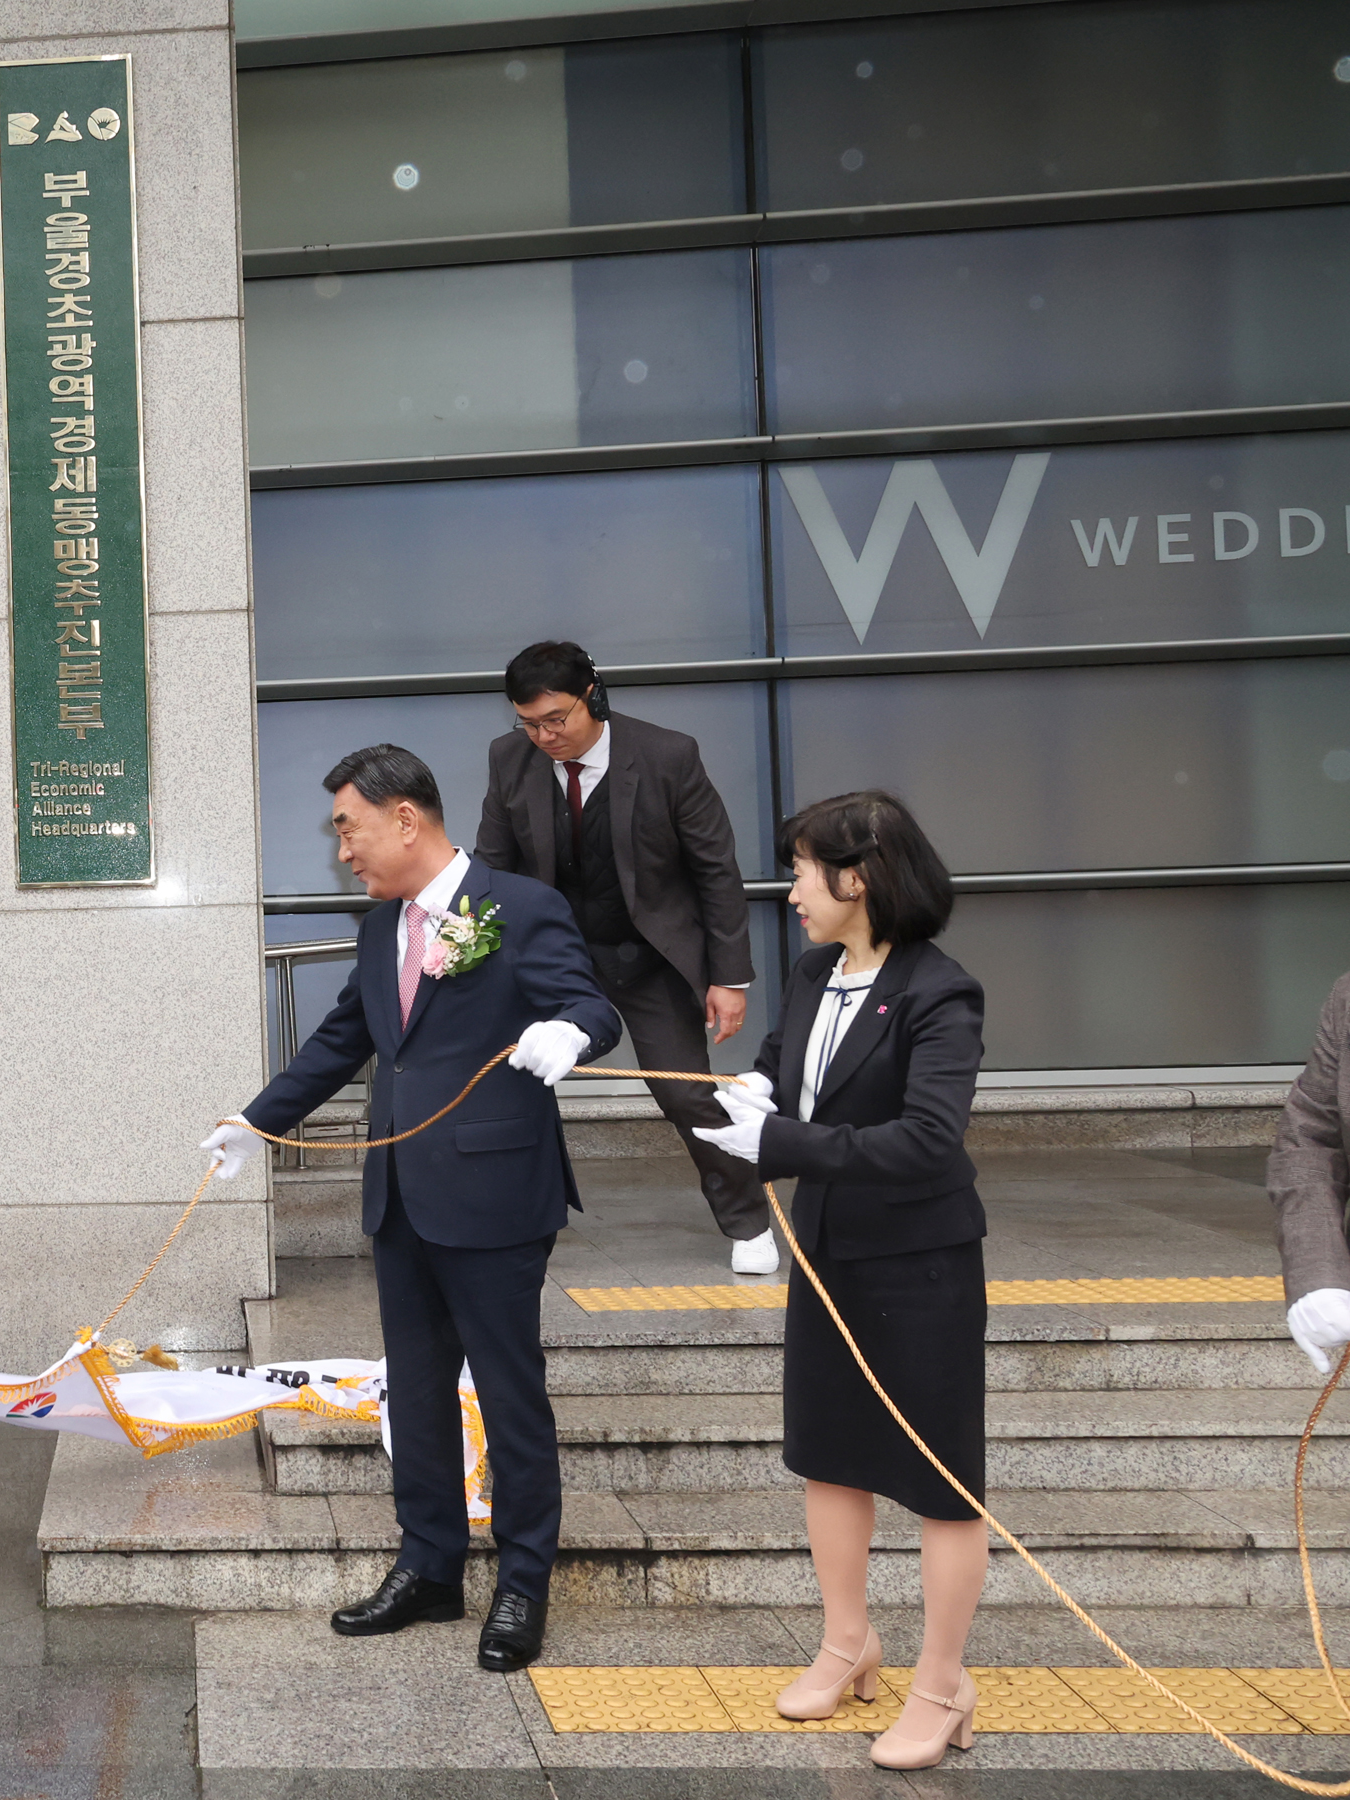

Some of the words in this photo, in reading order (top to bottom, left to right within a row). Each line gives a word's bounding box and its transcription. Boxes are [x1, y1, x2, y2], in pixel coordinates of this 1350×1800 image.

[42, 170, 106, 740] 부울경초광역경제동맹추진본부
[778, 452, 1050, 645] W
[30, 759, 125, 778] Tri-Regional
[30, 780, 105, 797] Economic
[32, 800, 91, 816] Alliance
[31, 818, 136, 838] Headquarters
